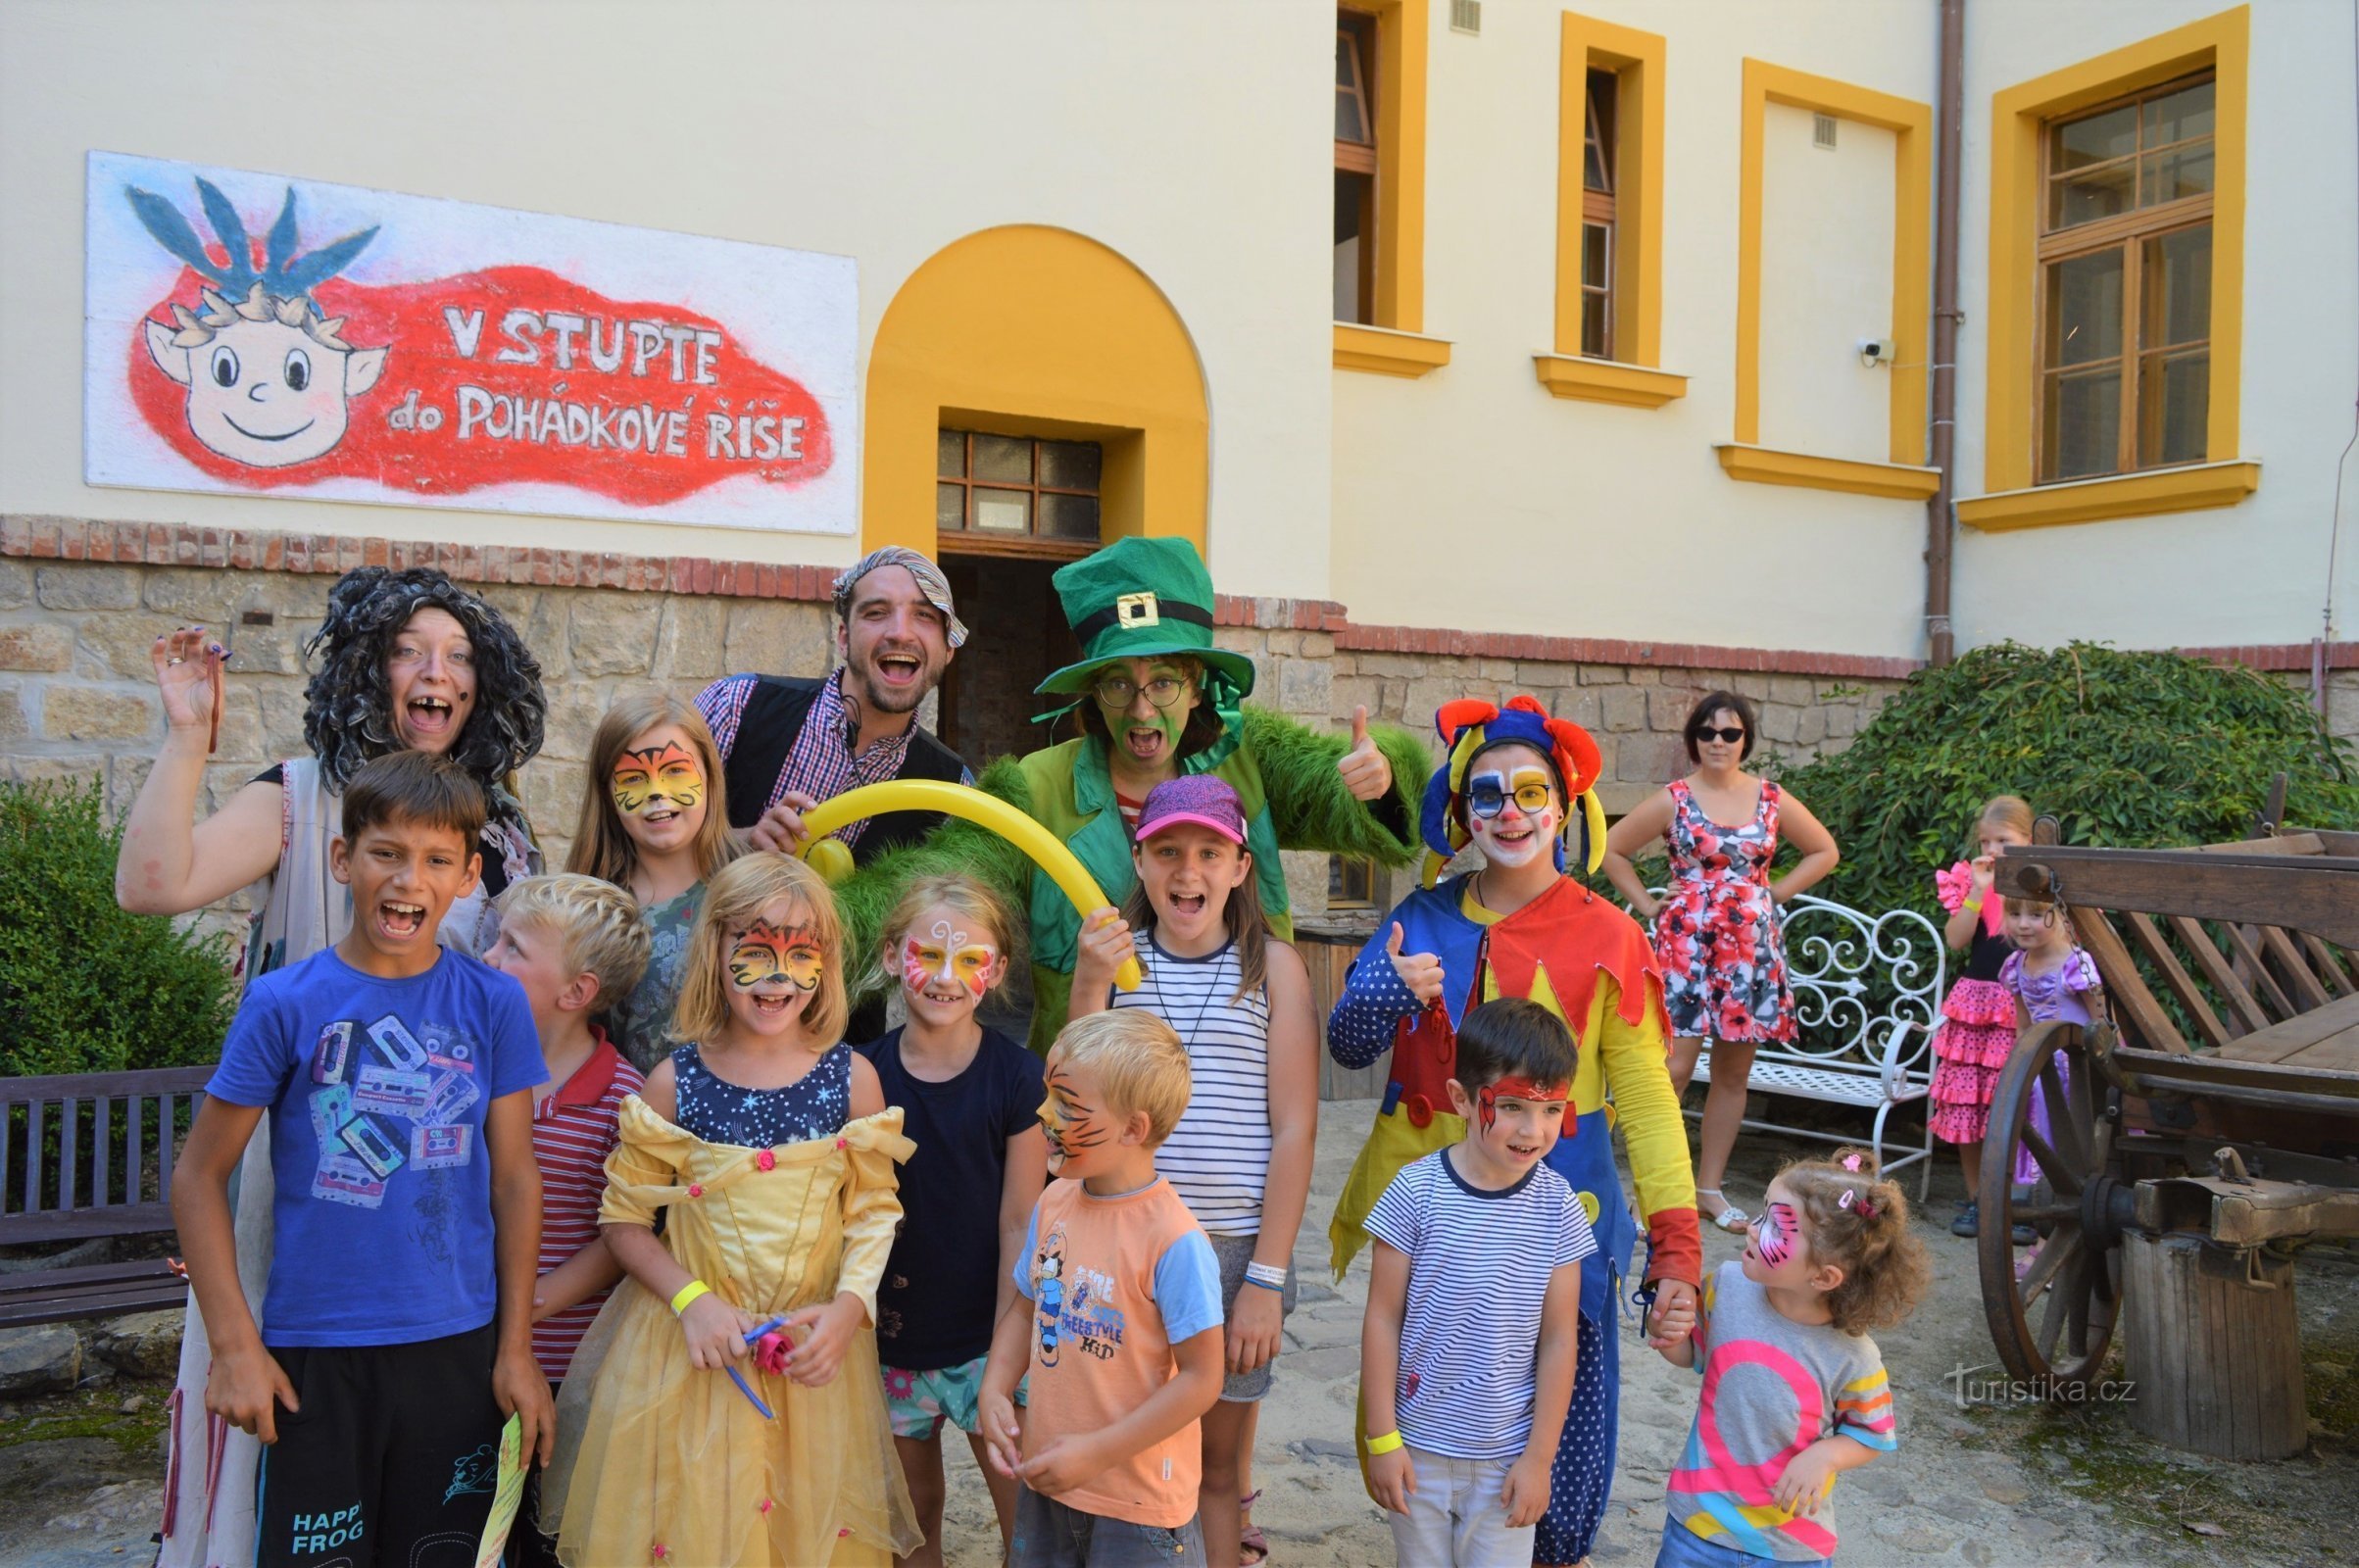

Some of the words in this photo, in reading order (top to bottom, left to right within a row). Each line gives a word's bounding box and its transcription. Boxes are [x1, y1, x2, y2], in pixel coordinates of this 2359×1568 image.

[387, 389, 443, 430] do
[457, 381, 695, 456] POHÁDKOVÉ
[707, 398, 805, 461] ŘÍŠE
[293, 1500, 363, 1532] HAPP
[291, 1520, 364, 1554] FROG
